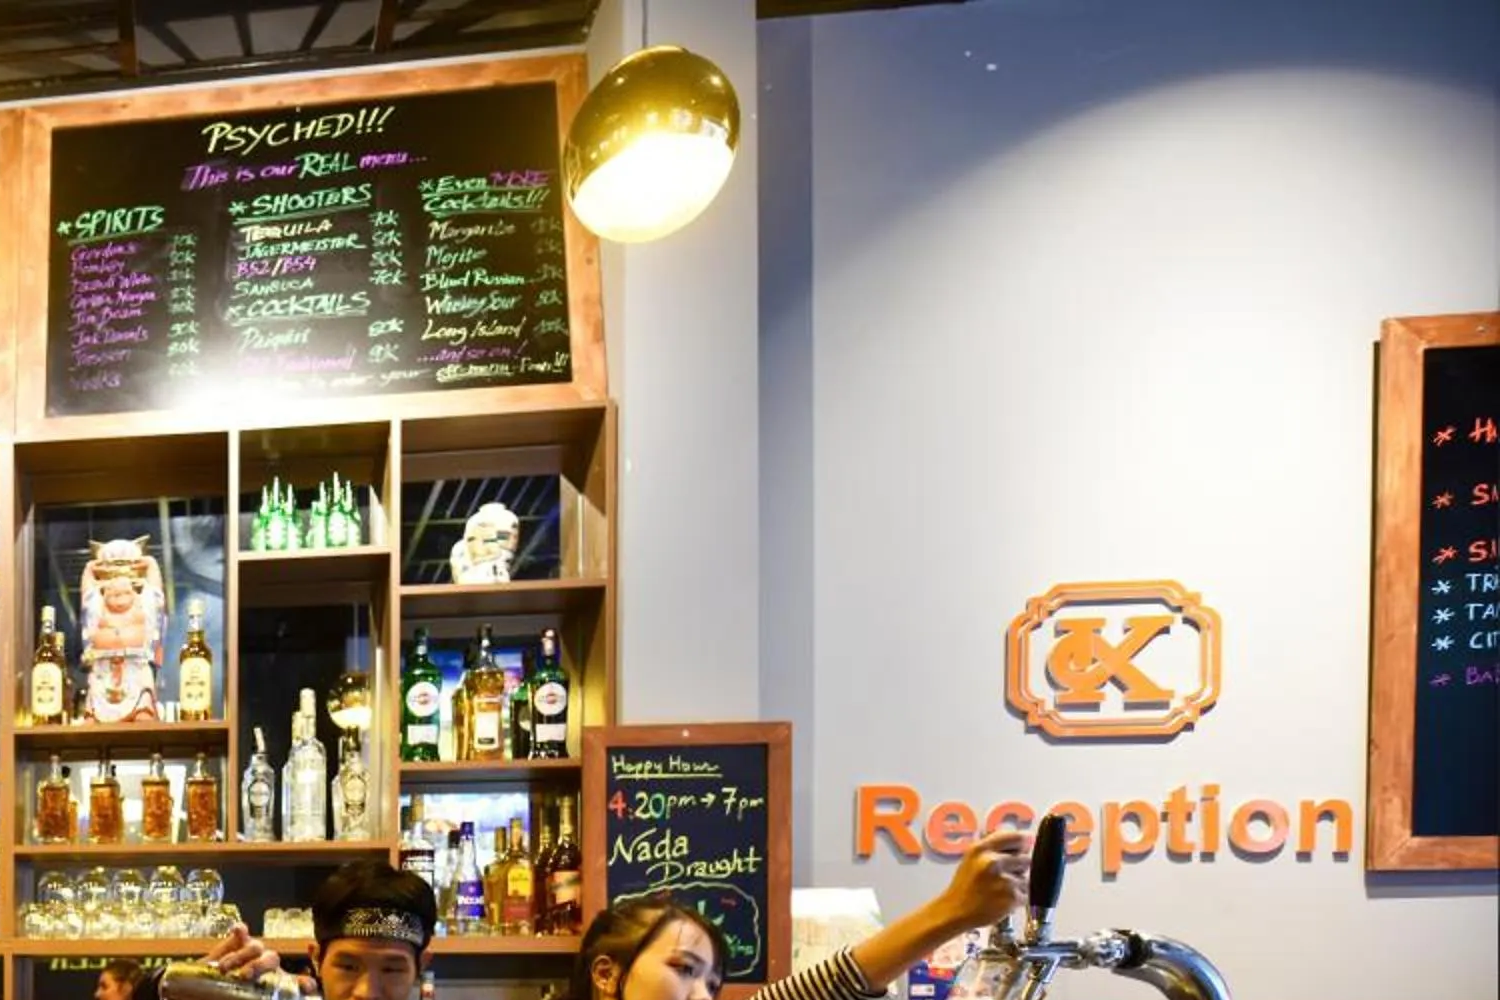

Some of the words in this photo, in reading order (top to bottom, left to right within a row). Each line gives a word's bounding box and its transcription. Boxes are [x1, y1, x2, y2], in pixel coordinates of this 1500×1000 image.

[201, 106, 395, 155] PSYCHED!!!
[235, 166, 255, 182] is
[295, 152, 357, 179] REAL
[251, 183, 373, 216] SHOOTERS
[75, 206, 165, 238] SPIRITS
[611, 754, 664, 778] Happy
[608, 827, 690, 867] Nada
[645, 846, 764, 886] Draught
